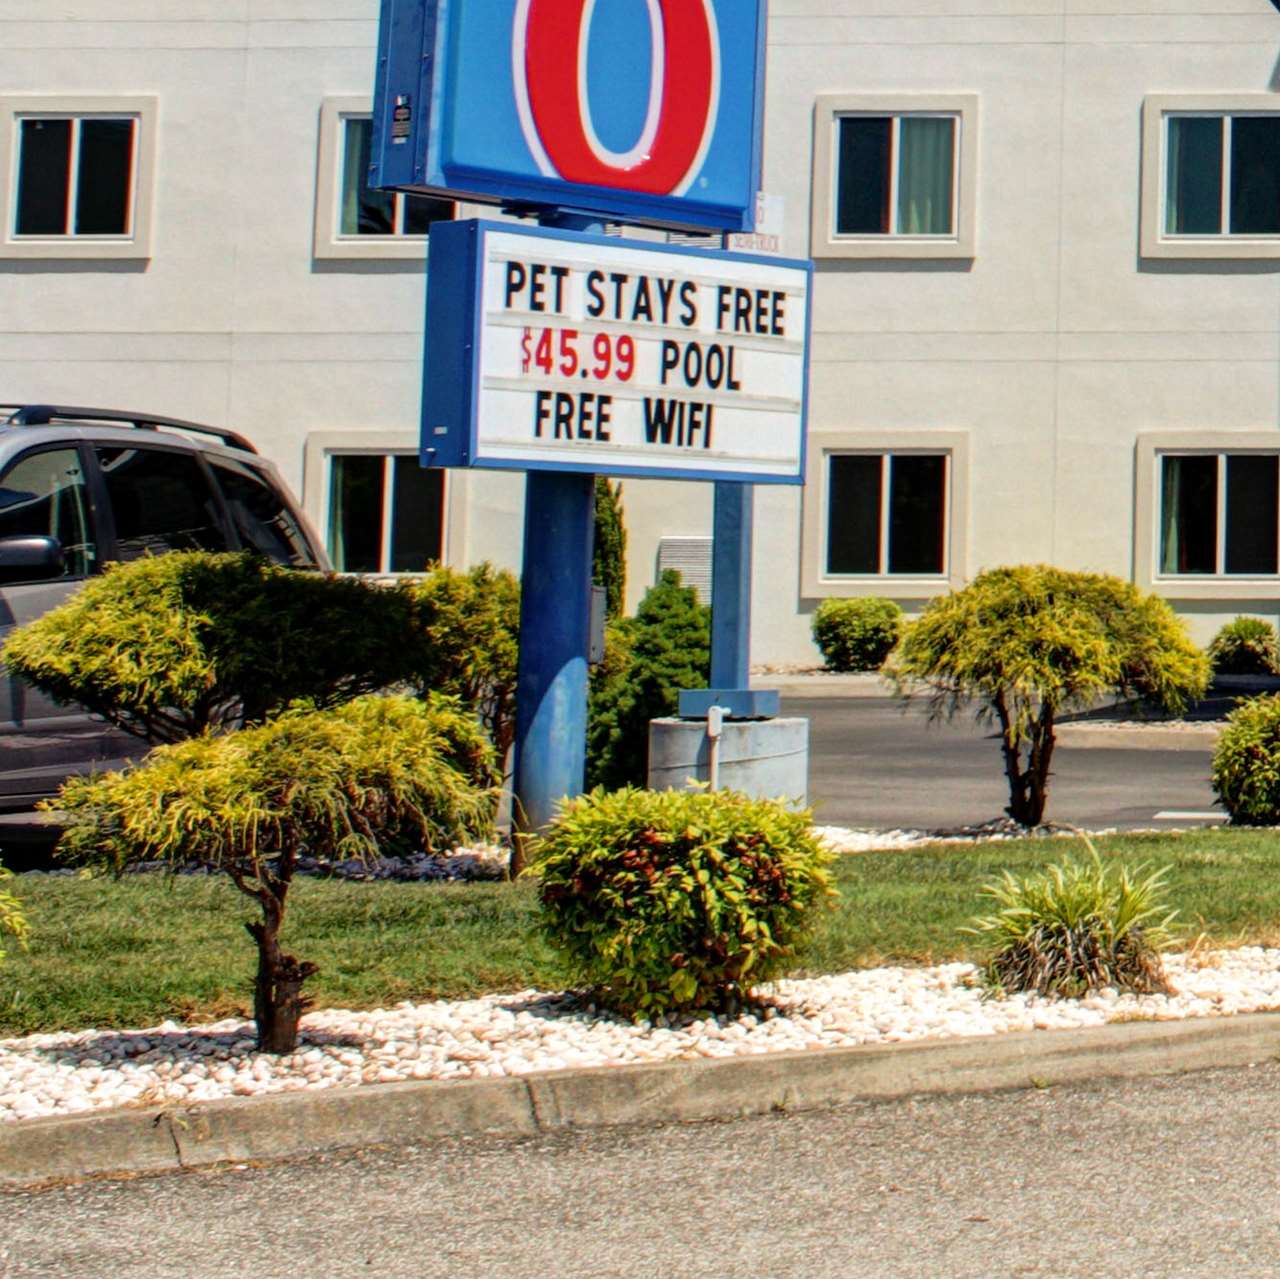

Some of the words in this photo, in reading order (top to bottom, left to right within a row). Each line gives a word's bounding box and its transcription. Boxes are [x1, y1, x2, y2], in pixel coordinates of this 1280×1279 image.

[505, 260, 571, 314] PET
[586, 270, 698, 327] STAYS
[716, 285, 787, 336] FREE
[521, 325, 637, 382] $45.99
[659, 339, 742, 392] POOL
[534, 390, 614, 442] FREE
[643, 397, 715, 449] WIFI
